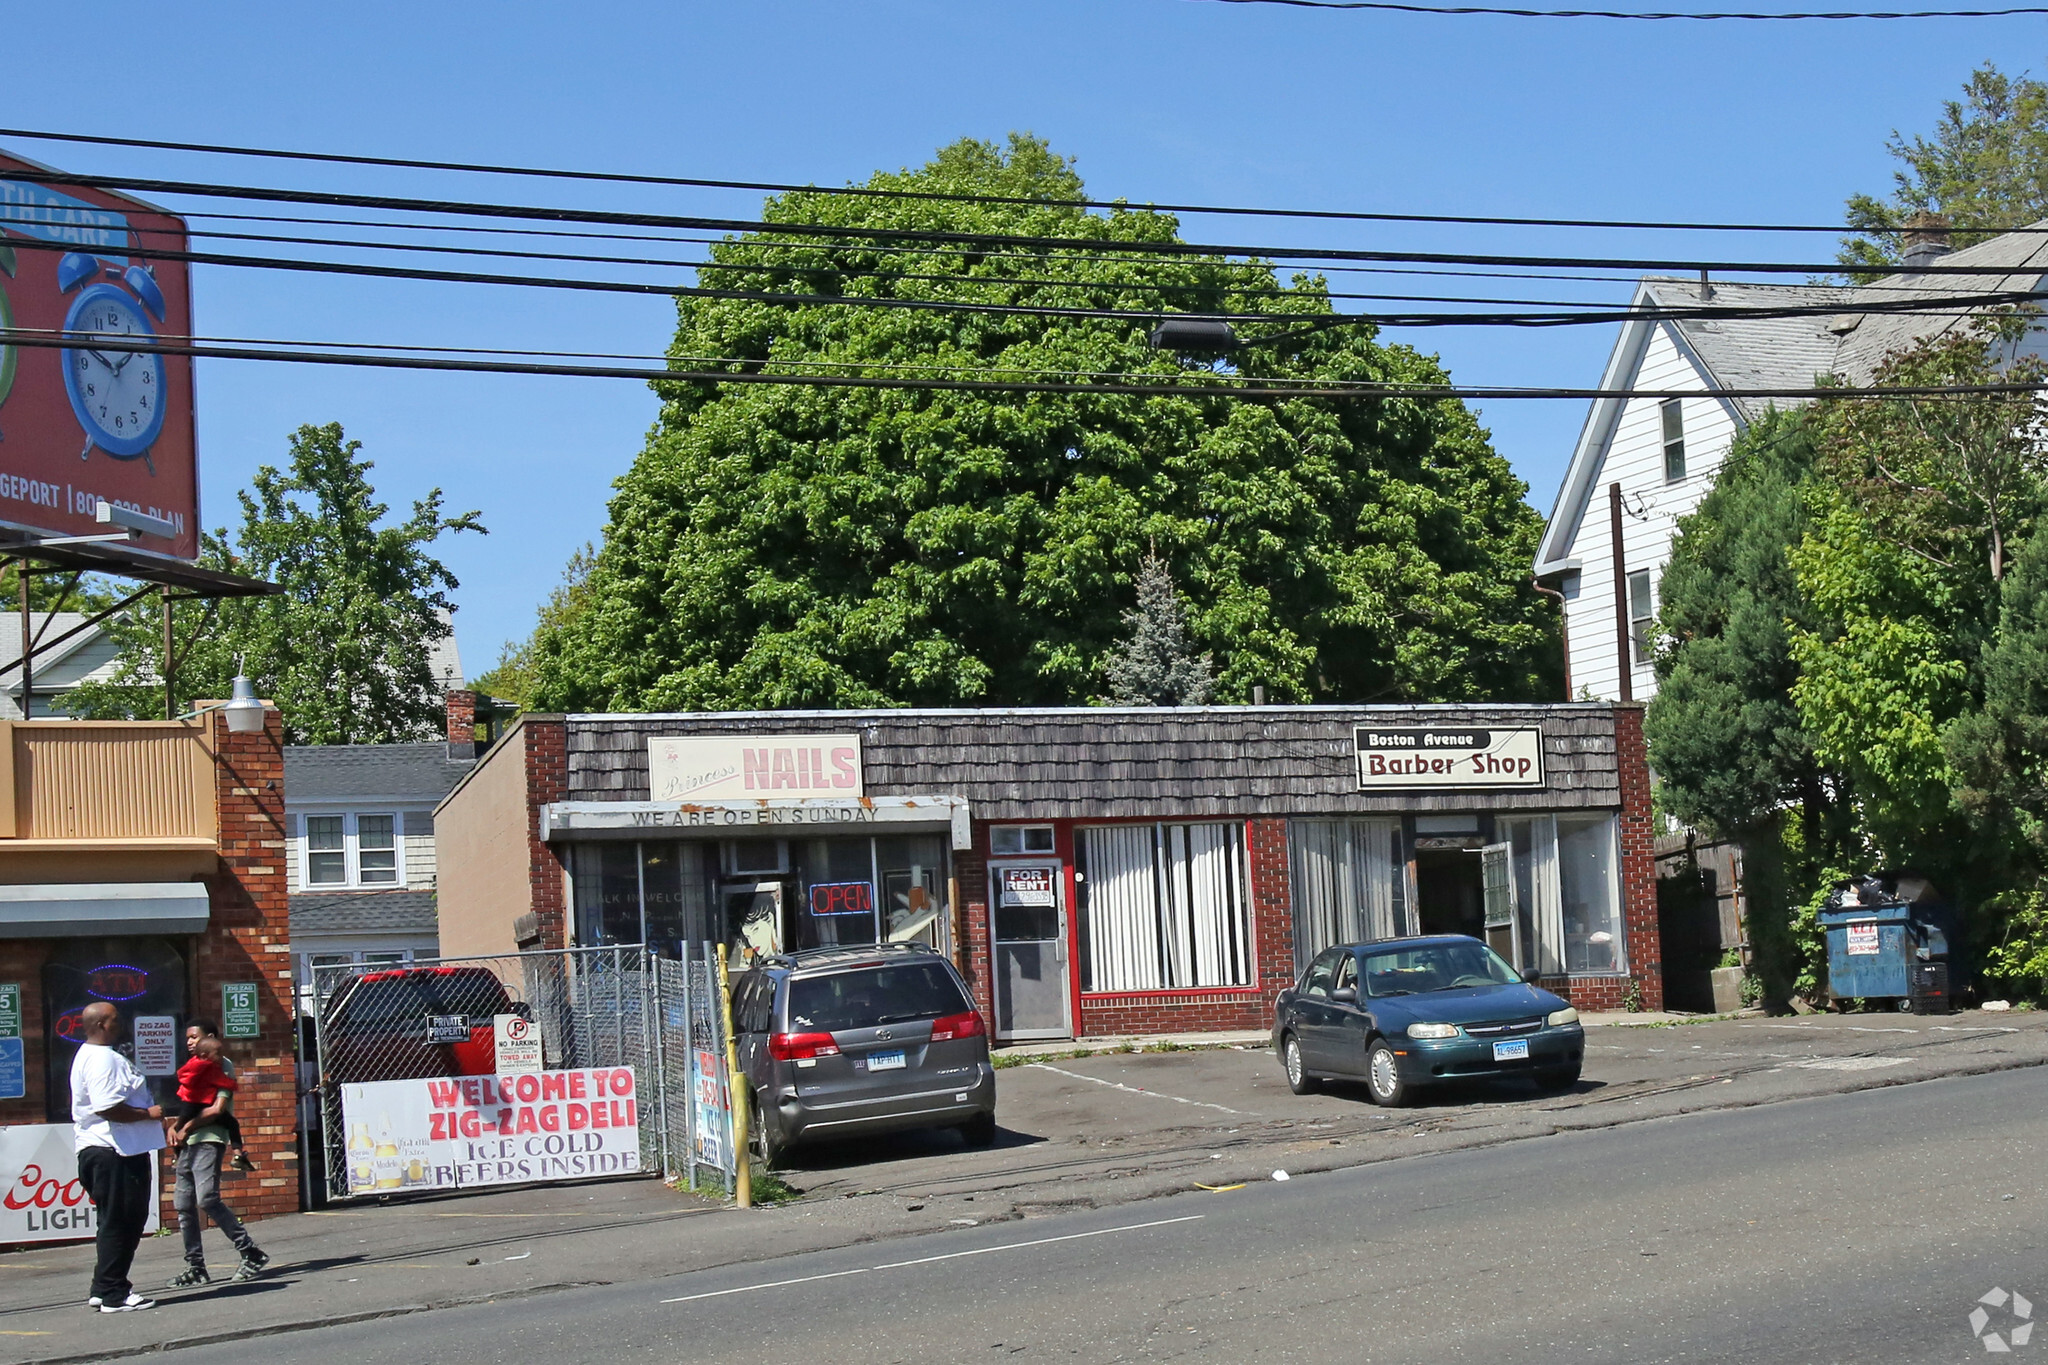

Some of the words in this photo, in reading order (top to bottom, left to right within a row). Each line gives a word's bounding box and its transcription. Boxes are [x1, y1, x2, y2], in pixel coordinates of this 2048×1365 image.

[1368, 733, 1415, 747] Boston
[1423, 733, 1474, 746] Avenue
[660, 764, 736, 797] Princess
[742, 747, 856, 790] NAILS
[1368, 754, 1454, 775] Barber
[1471, 752, 1531, 778] Shop
[633, 812, 664, 826] WE
[672, 810, 715, 826] ARE
[724, 809, 783, 824] OPEN
[792, 808, 878, 823] SUNDAY
[1006, 880, 1048, 891] RENT
[1010, 870, 1042, 880] FOR
[813, 885, 871, 913] OPEN
[91, 973, 146, 992] ATM
[230, 993, 249, 1007] 15
[429, 1026, 467, 1036] PROPERTY
[433, 1016, 463, 1026] PRIVATE
[427, 1071, 586, 1108] WELCOME
[592, 1068, 633, 1097] TO
[429, 1104, 560, 1140] ZIG-ZAG
[567, 1099, 636, 1130] DELI
[467, 1138, 516, 1161] ICE
[524, 1132, 604, 1156] COLD
[435, 1159, 531, 1186] BEERS
[540, 1151, 638, 1177] INSIDE
[27, 1207, 97, 1232] LIGH
